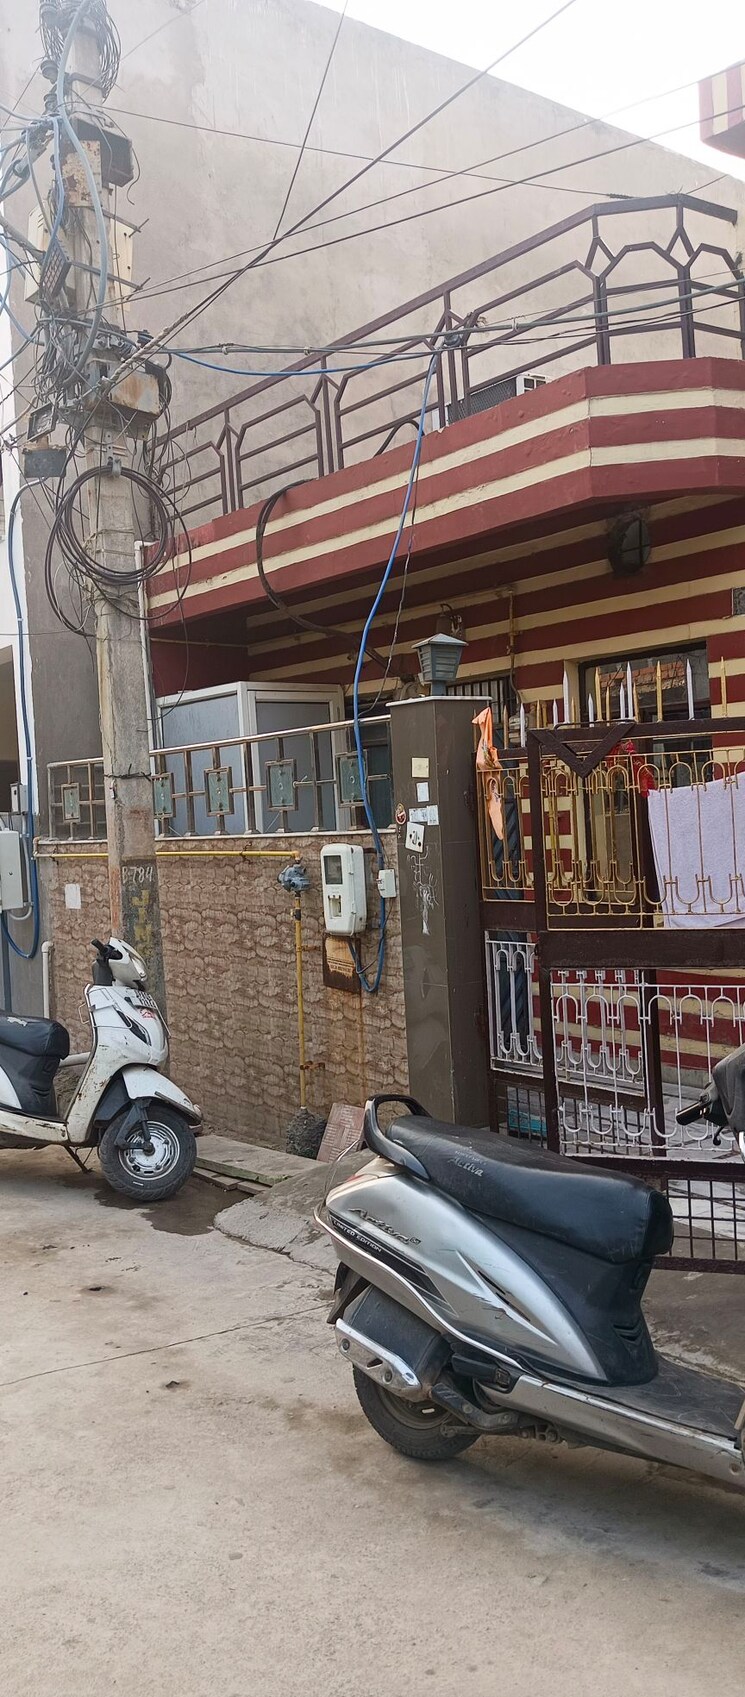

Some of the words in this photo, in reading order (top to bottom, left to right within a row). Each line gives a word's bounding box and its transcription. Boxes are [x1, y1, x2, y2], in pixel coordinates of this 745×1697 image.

[447, 1156, 484, 1177] Activa
[333, 1220, 356, 1237] LIMITED
[356, 1233, 382, 1253] EDITION
[347, 1207, 411, 1245] Activa
